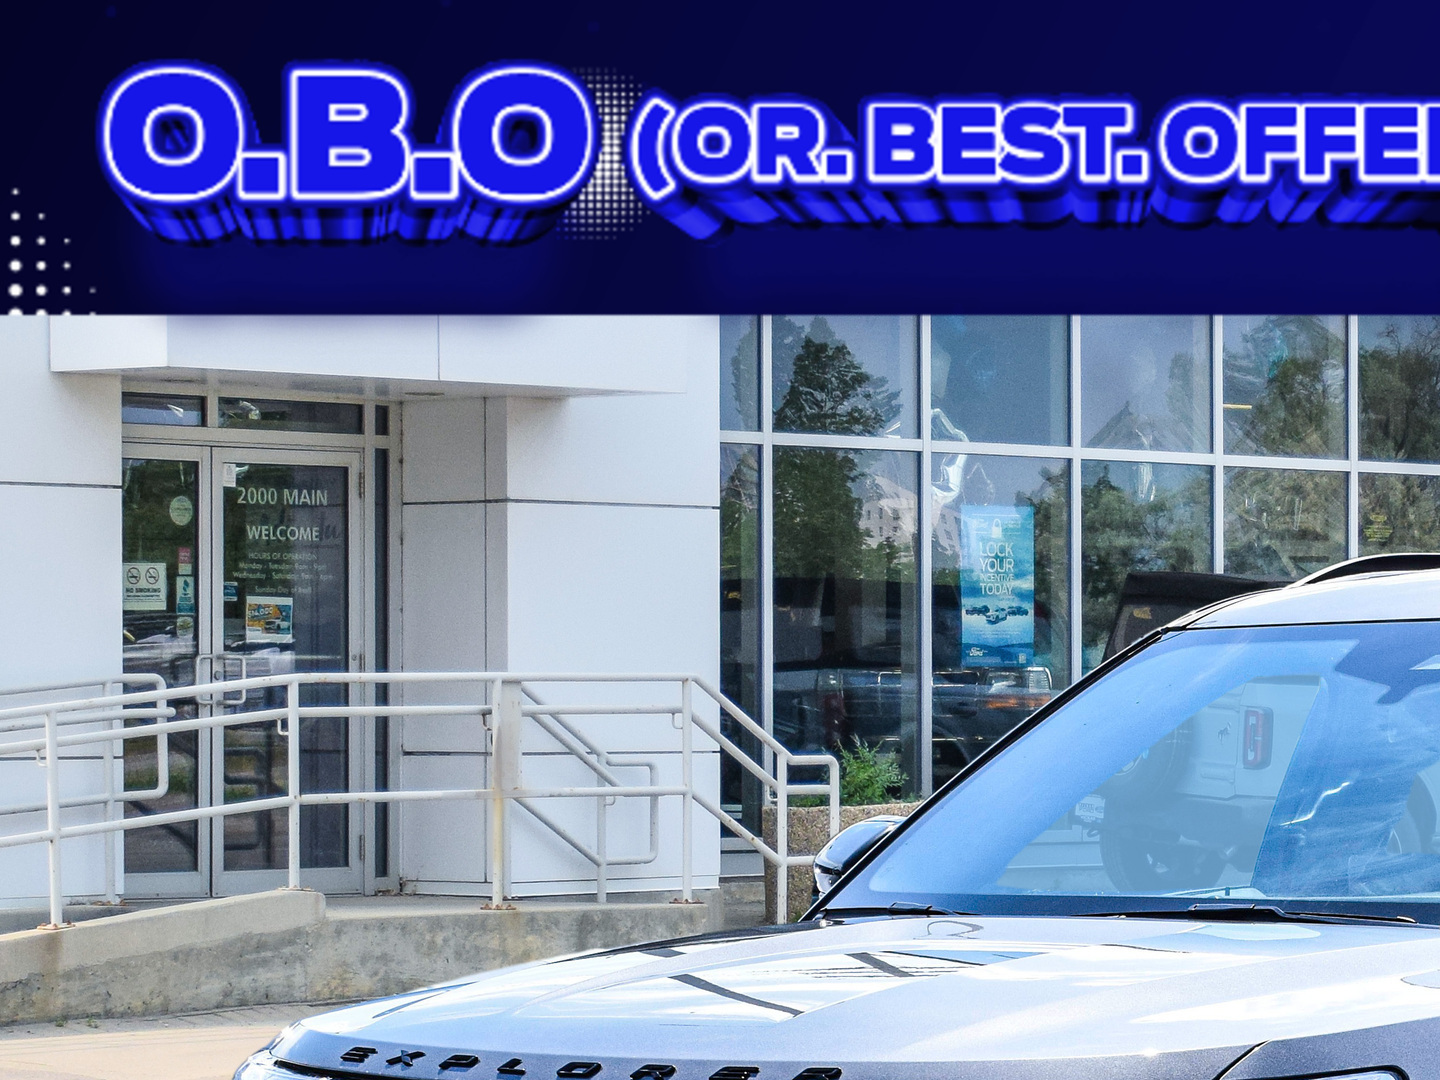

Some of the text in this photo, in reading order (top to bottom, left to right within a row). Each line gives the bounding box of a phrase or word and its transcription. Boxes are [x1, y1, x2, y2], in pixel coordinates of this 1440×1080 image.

[237, 487, 328, 506] 2000 MAIN
[246, 525, 320, 541] WELCOME
[248, 552, 271, 560] HOURS
[979, 541, 1014, 557] LOCK
[979, 558, 1015, 572] YOUR
[979, 583, 1014, 595] TODAY
